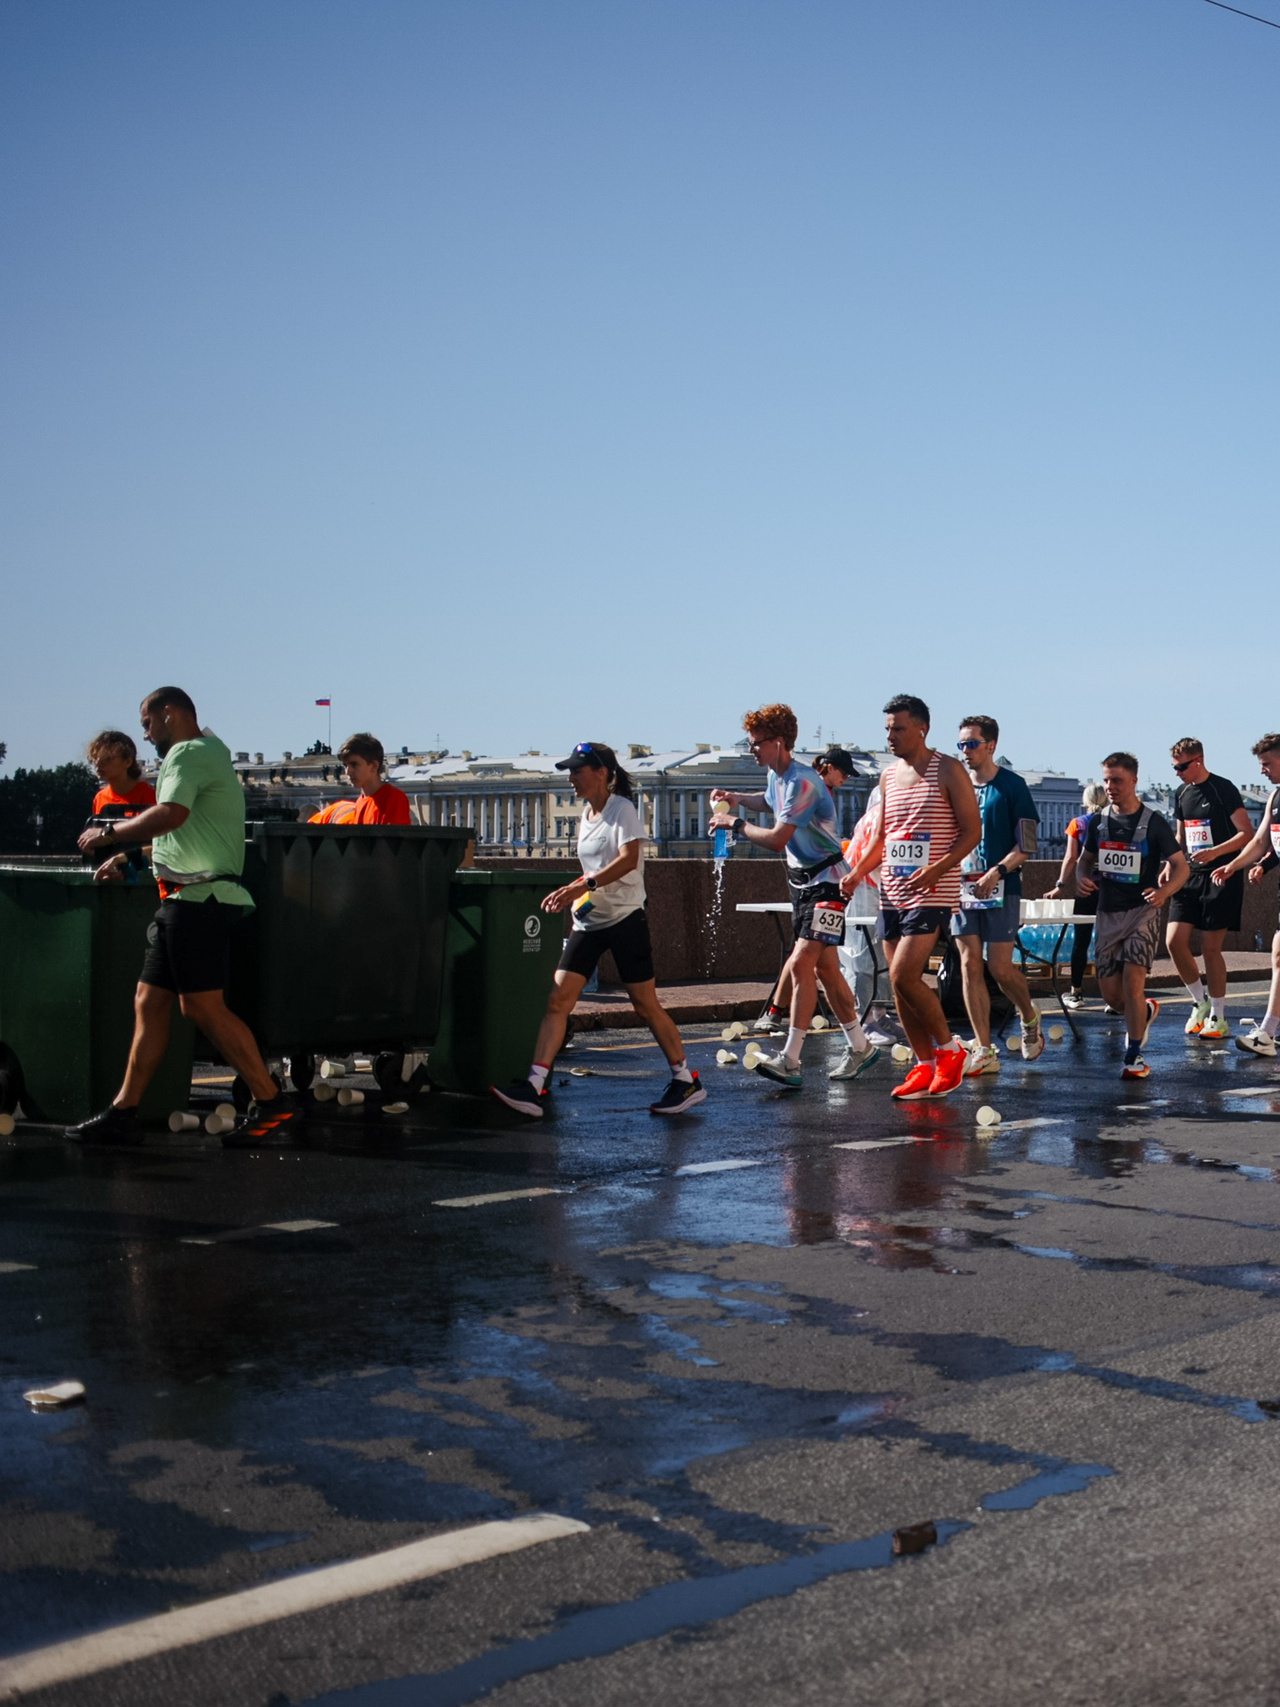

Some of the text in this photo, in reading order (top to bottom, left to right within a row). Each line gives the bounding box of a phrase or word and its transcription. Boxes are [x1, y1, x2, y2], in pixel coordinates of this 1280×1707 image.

[891, 844, 923, 858] 6013
[1104, 853, 1134, 867] 6001
[819, 912, 843, 928] 637
